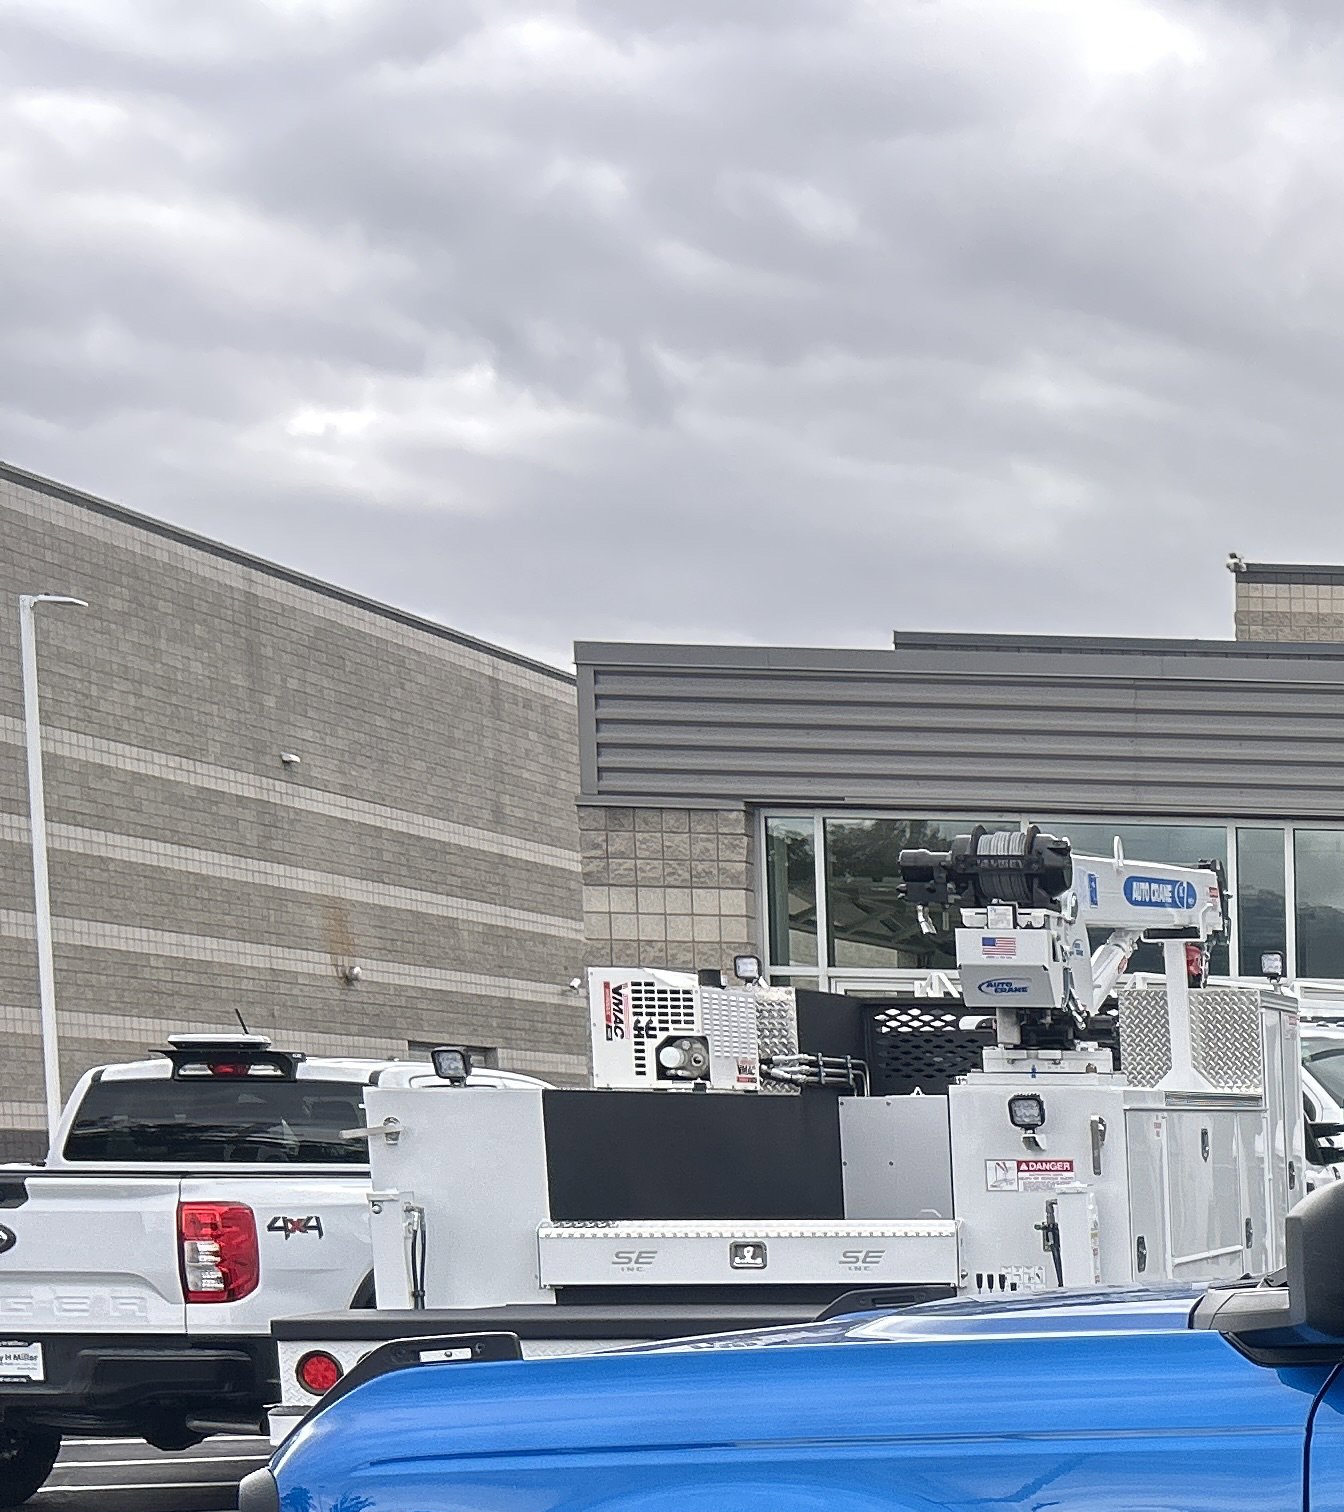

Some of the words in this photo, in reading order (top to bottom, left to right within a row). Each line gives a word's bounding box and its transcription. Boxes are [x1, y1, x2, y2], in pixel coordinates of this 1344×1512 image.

[1132, 881, 1149, 902] AUTO
[1150, 882, 1172, 903] CRANE
[611, 984, 625, 1040] VMAC
[1029, 1161, 1071, 1171] DANGER
[611, 1250, 658, 1265] SE
[838, 1250, 886, 1265] SE
